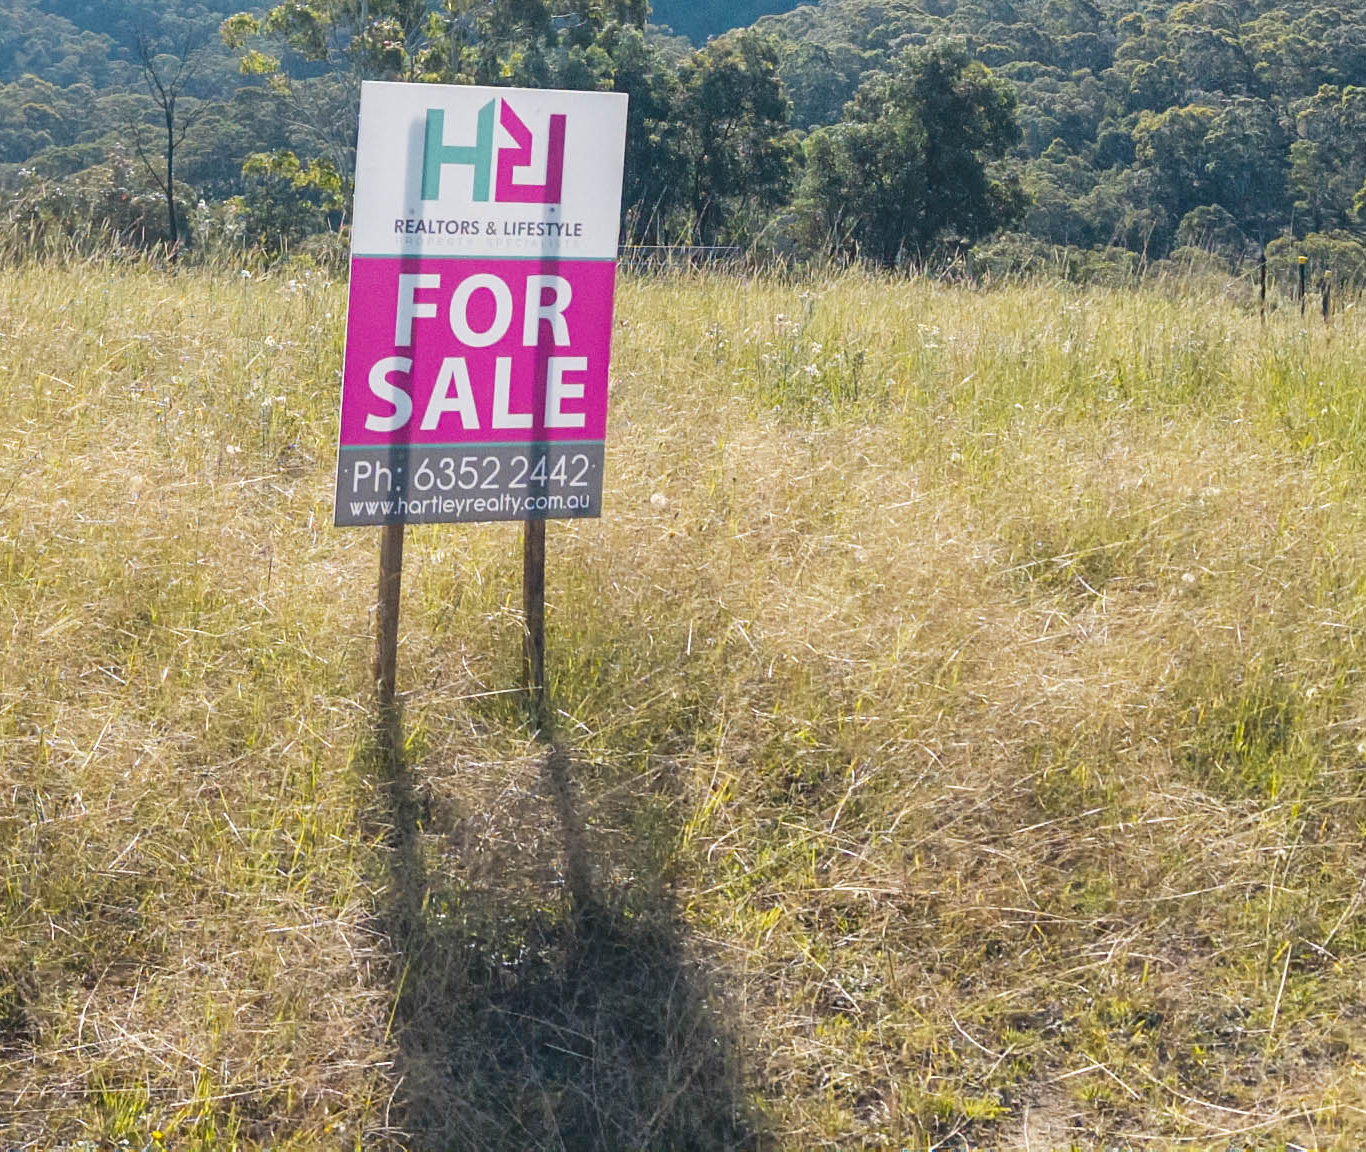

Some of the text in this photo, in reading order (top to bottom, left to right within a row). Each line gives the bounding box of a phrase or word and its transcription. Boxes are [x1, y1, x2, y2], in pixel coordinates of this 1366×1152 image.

[394, 219, 582, 237] REALTORS & LIFESTYLE
[394, 273, 572, 347] FOR
[364, 356, 588, 432] SALE
[352, 454, 590, 493] Ph: 6352 2442
[349, 493, 590, 517] www.hartleyrealty.com.au
